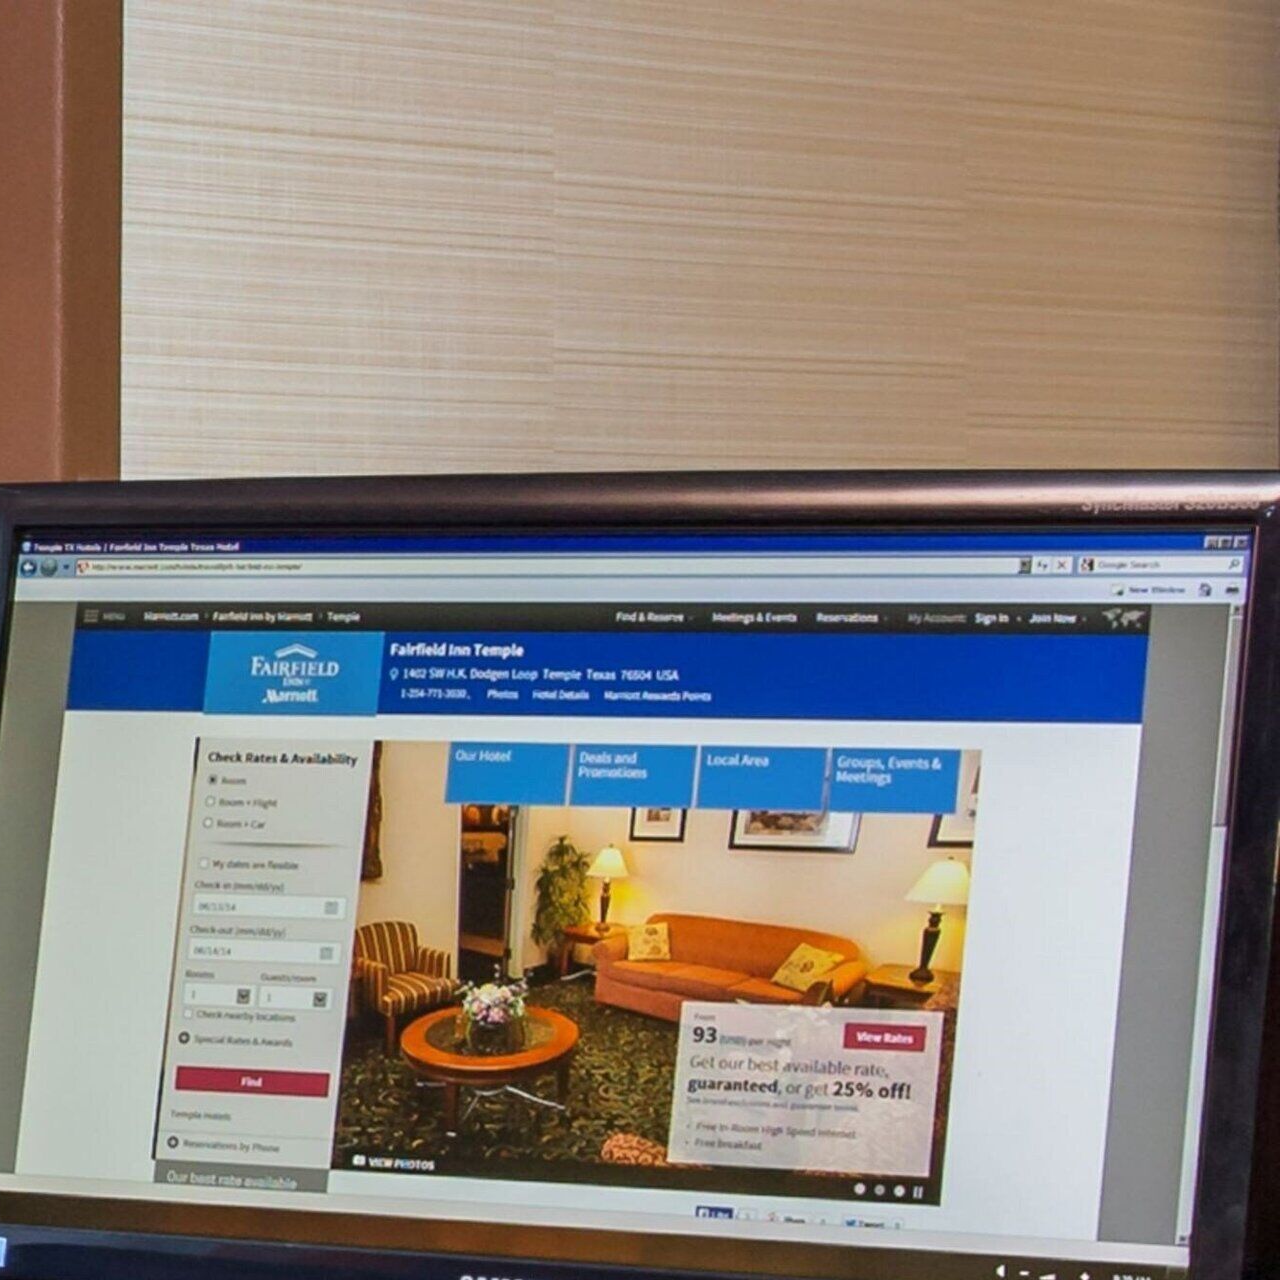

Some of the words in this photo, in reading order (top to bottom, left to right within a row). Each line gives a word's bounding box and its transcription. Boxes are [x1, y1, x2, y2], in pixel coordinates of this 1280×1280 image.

[211, 611, 249, 622] Fairfield
[264, 612, 277, 624] by
[327, 612, 361, 624] Temple
[615, 611, 637, 623] Find
[647, 612, 685, 623] Reserve
[712, 612, 755, 625] Meetings
[765, 612, 798, 624] Events
[816, 612, 879, 624] Reservations
[974, 612, 997, 626] Sign
[1029, 613, 1051, 624] Join
[390, 643, 446, 657] Fairfield
[448, 643, 472, 657] Inn
[474, 643, 525, 660] Temple
[250, 655, 340, 678] FAIRFIELD
[469, 669, 510, 683] Dodgen
[511, 669, 539, 683] Loop
[543, 669, 582, 682] Temple
[586, 670, 617, 681] Texas
[656, 670, 680, 682] USA
[487, 689, 519, 700] Photos
[532, 690, 557, 700] Hotel
[558, 690, 590, 701] Details
[682, 691, 712, 702] Points
[208, 752, 242, 764] Check
[245, 753, 278, 764] Rates
[279, 753, 289, 764] &
[291, 753, 358, 768] Availability
[455, 750, 476, 762] Our
[479, 750, 512, 763] Hotel
[579, 751, 612, 764] Deals
[614, 751, 638, 764] and
[706, 754, 740, 767] Local
[740, 755, 770, 768] Area
[837, 755, 885, 773] Groups,
[889, 757, 929, 770] Events
[932, 756, 942, 770] &
[578, 766, 648, 779] Promotions
[836, 771, 892, 787] Meetings
[212, 860, 225, 870] My
[226, 859, 251, 870] dates
[252, 861, 266, 870] are
[196, 1010, 222, 1020] Check
[223, 1011, 255, 1024] nearby
[255, 1011, 297, 1023] locations
[194, 1034, 225, 1046] Special
[226, 1036, 251, 1046] Rates
[692, 1026, 718, 1044] 93
[856, 1031, 882, 1044] View
[883, 1032, 914, 1046] Rates
[690, 1055, 715, 1069] Get
[718, 1059, 745, 1070] our
[747, 1056, 779, 1073] best
[782, 1057, 852, 1075] available
[854, 1061, 890, 1079] rate,
[240, 1076, 263, 1088] Find
[687, 1077, 783, 1095] guaranteed,
[785, 1083, 803, 1093] or
[804, 1082, 830, 1099] get
[833, 1080, 874, 1098] 25%
[878, 1081, 912, 1100] off!
[696, 1121, 717, 1131] Free
[761, 1125, 784, 1136] High
[786, 1127, 817, 1138] Speed
[240, 1141, 250, 1153] by
[252, 1142, 280, 1153] Phone
[694, 1138, 716, 1148] Free
[368, 1157, 392, 1169] VIEW
[394, 1158, 435, 1171] PHOTOS
[166, 1169, 188, 1183] Our
[190, 1170, 217, 1184] best
[218, 1172, 242, 1187] rate
